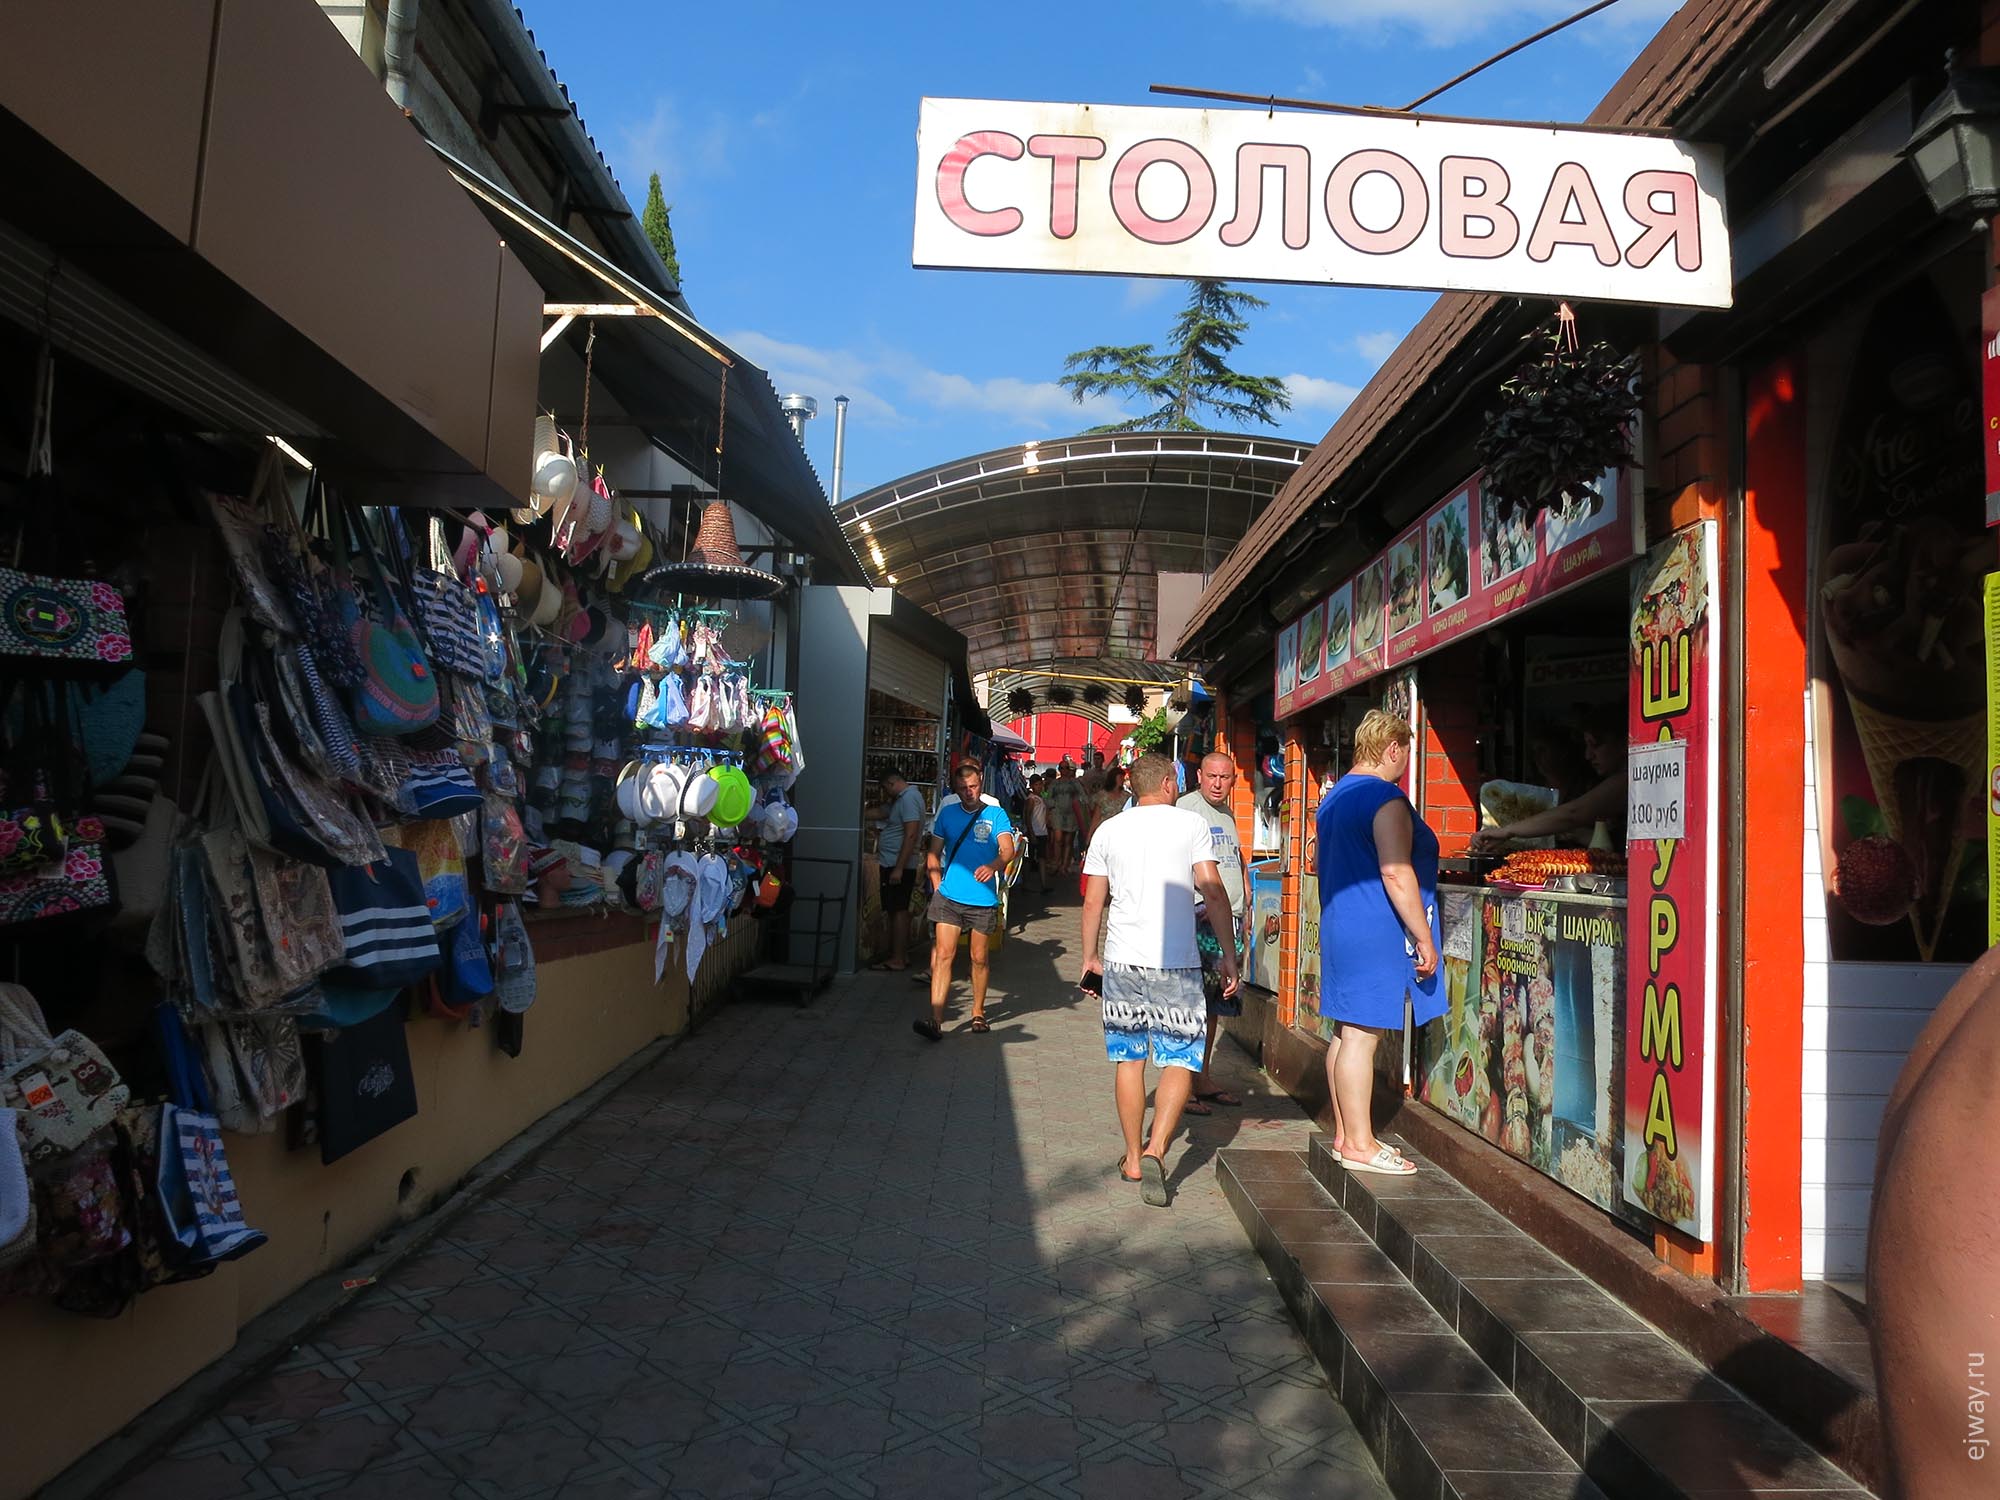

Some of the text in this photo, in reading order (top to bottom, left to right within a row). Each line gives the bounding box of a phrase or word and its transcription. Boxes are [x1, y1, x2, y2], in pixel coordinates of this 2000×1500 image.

[935, 129, 1702, 272] СТОЛОВАЯ
[1632, 761, 1680, 784] шаурма
[1631, 800, 1679, 829] 100 руб
[1640, 629, 1692, 1161] ШУРМА
[1493, 904, 1546, 936] ШЫК
[1563, 914, 1624, 948] ШАУРМА
[1496, 951, 1538, 979] баранина
